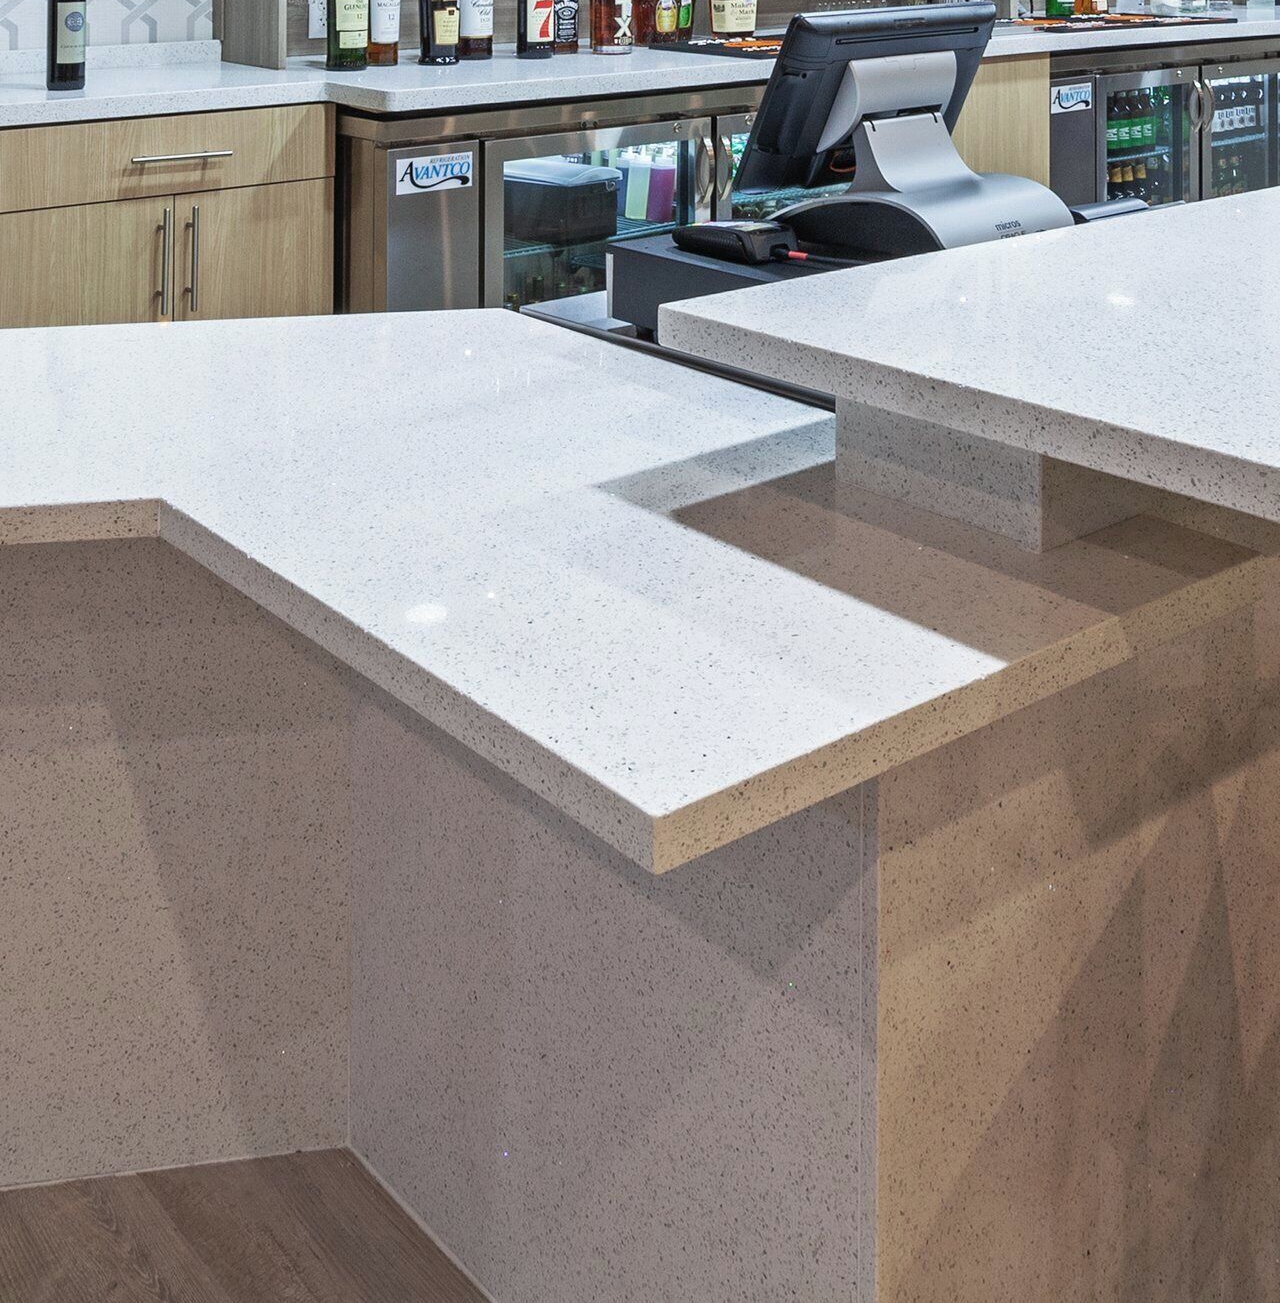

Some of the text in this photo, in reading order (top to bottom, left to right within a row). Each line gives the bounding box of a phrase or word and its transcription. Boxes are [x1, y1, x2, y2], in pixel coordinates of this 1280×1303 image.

[388, 13, 395, 21] 12
[533, 0, 553, 38] 7
[1052, 88, 1091, 110] AVANTCO
[1106, 127, 1118, 141] IPA
[1118, 126, 1130, 140] IPA
[1130, 125, 1142, 138] IPA
[1143, 123, 1152, 136] IPA
[398, 160, 471, 189] AVANTCO
[994, 219, 1022, 231] micros
